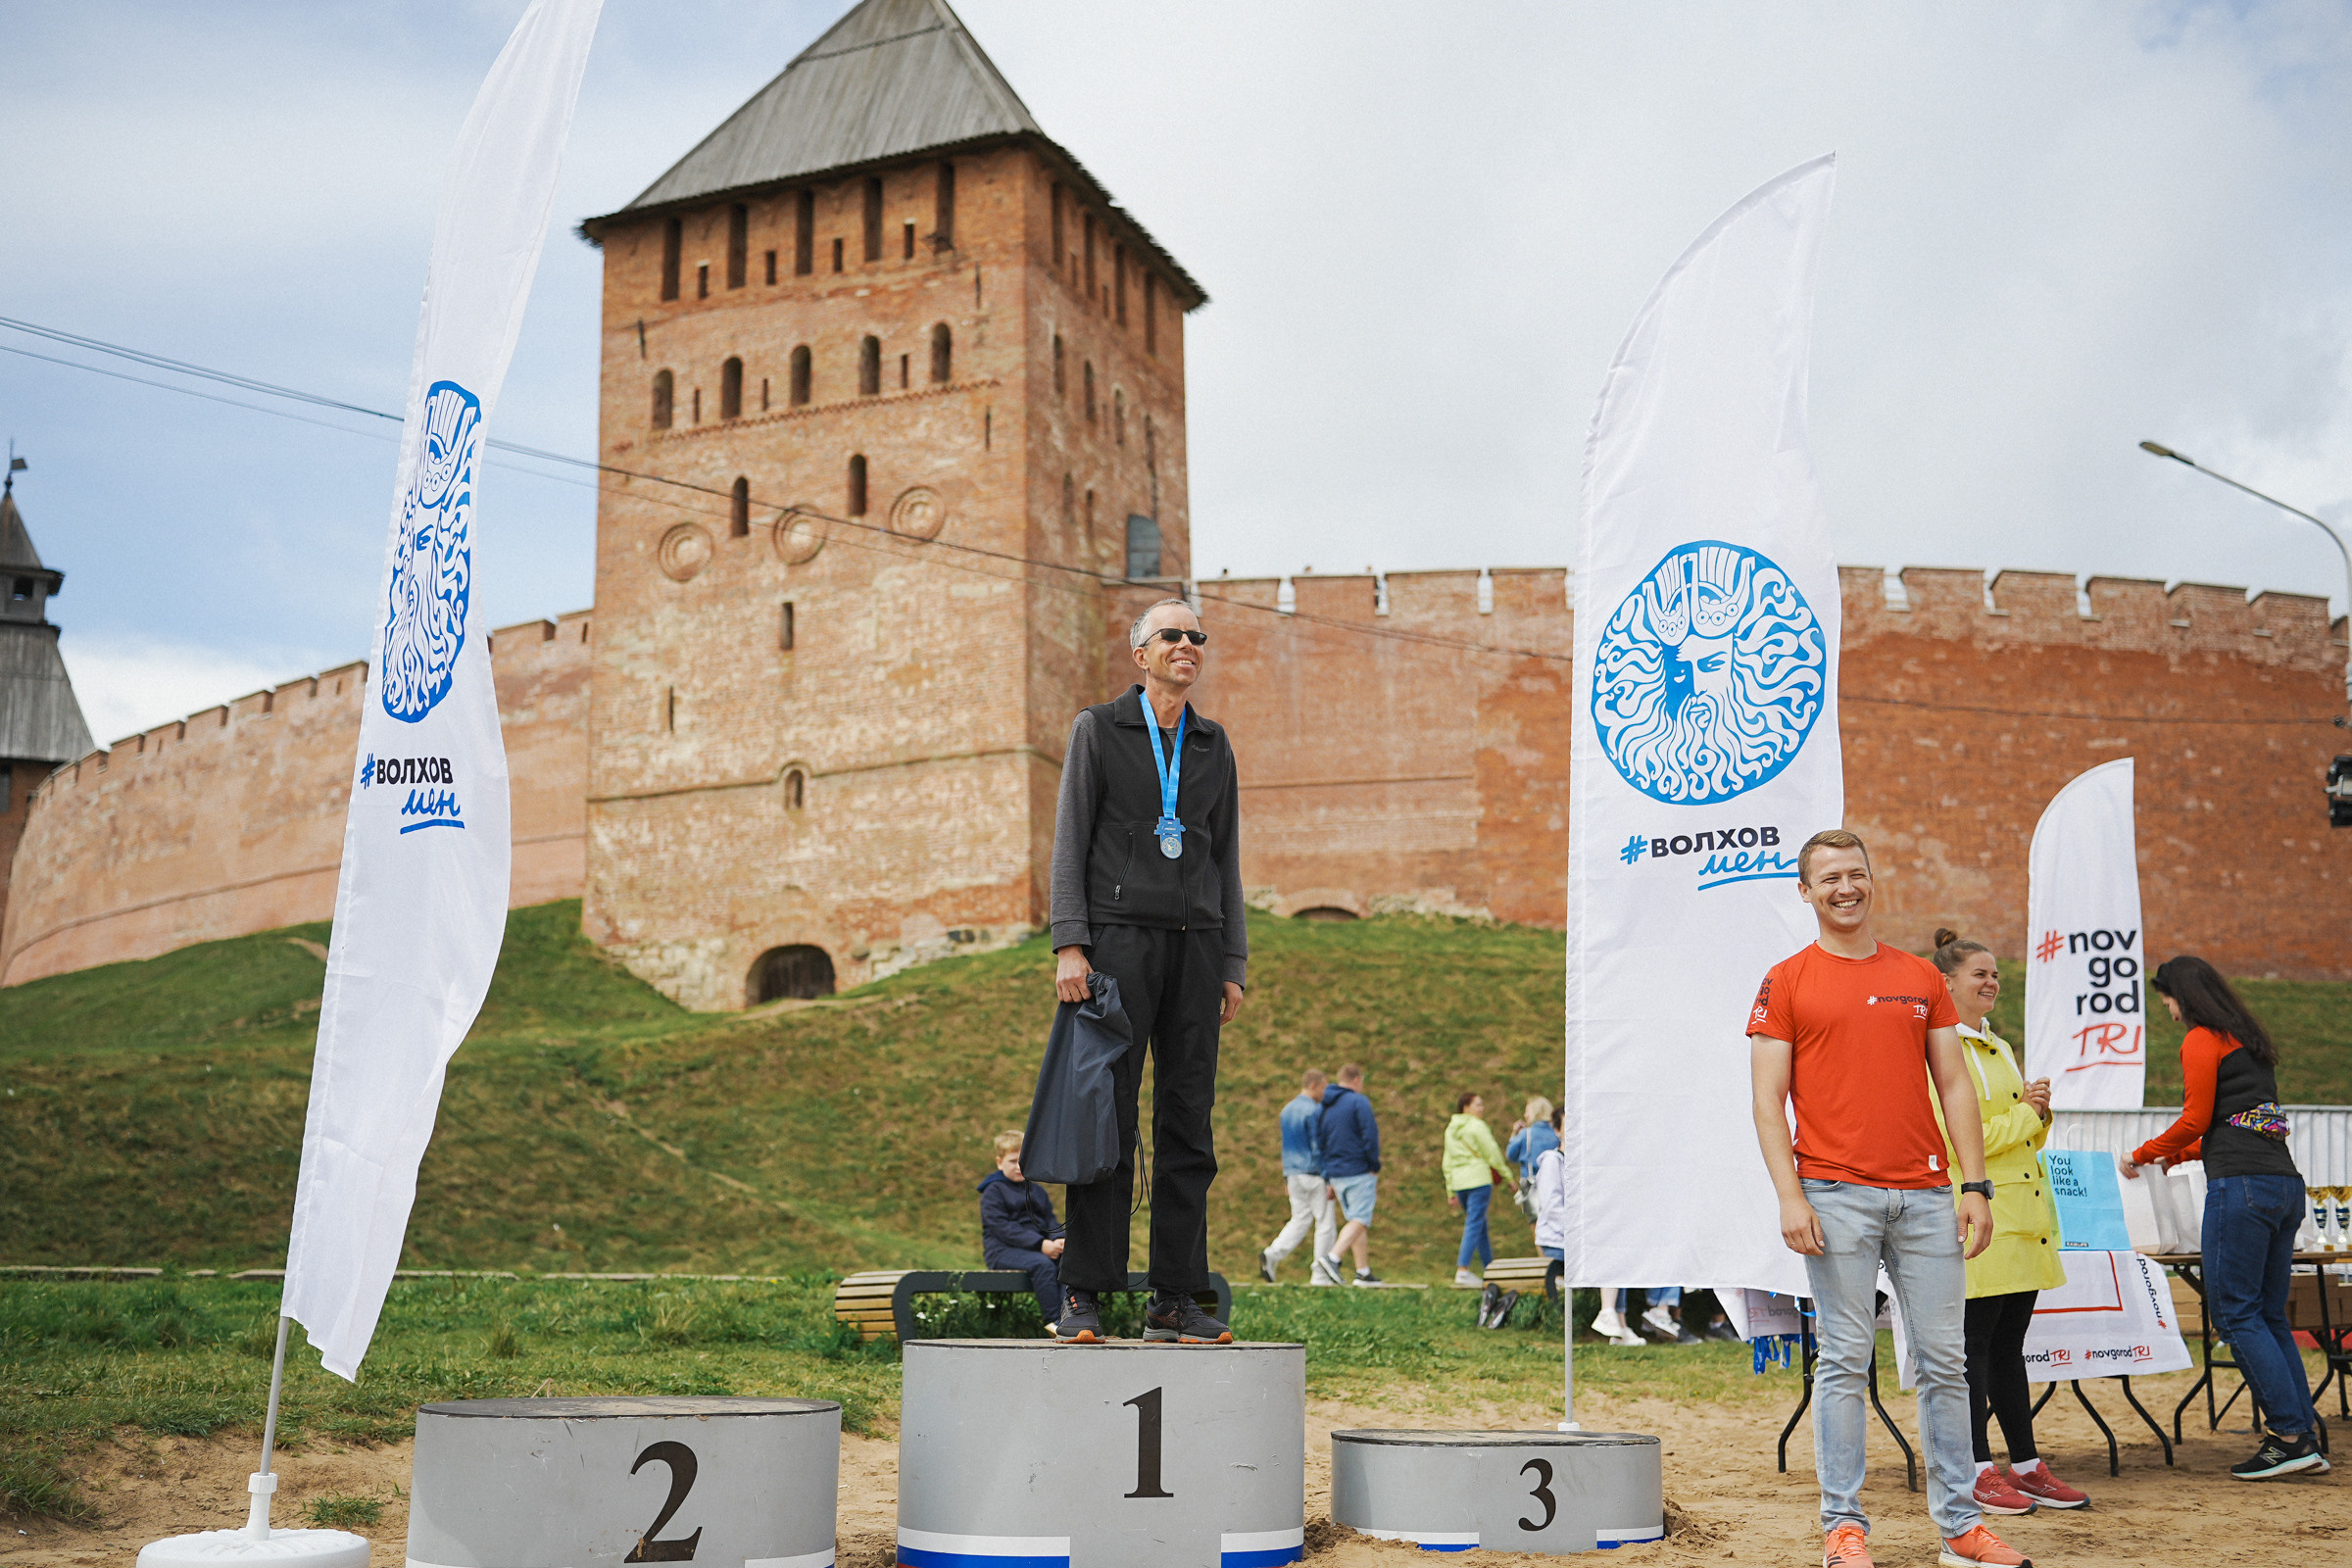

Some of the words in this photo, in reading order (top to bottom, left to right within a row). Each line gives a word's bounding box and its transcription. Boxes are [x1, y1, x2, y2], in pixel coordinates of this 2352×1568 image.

[360, 753, 454, 790] #ВОЛХОВ
[401, 788, 461, 817] мен
[1619, 826, 1781, 865] #ВОЛХОВ
[1697, 851, 1798, 876] мен
[2036, 930, 2136, 962] #nov
[2088, 956, 2138, 988] go
[1866, 995, 1929, 1006] #novgorod
[2077, 980, 2139, 1015] rod
[2072, 1022, 2141, 1056] TRI
[2048, 1154, 2071, 1166] You
[2050, 1165, 2074, 1176] look
[2052, 1175, 2072, 1186] like
[2073, 1178, 2079, 1187] a
[2054, 1187, 2088, 1198] snack!
[1122, 1386, 1174, 1498] 1
[623, 1440, 704, 1564] 2
[1518, 1457, 1557, 1532] 3
